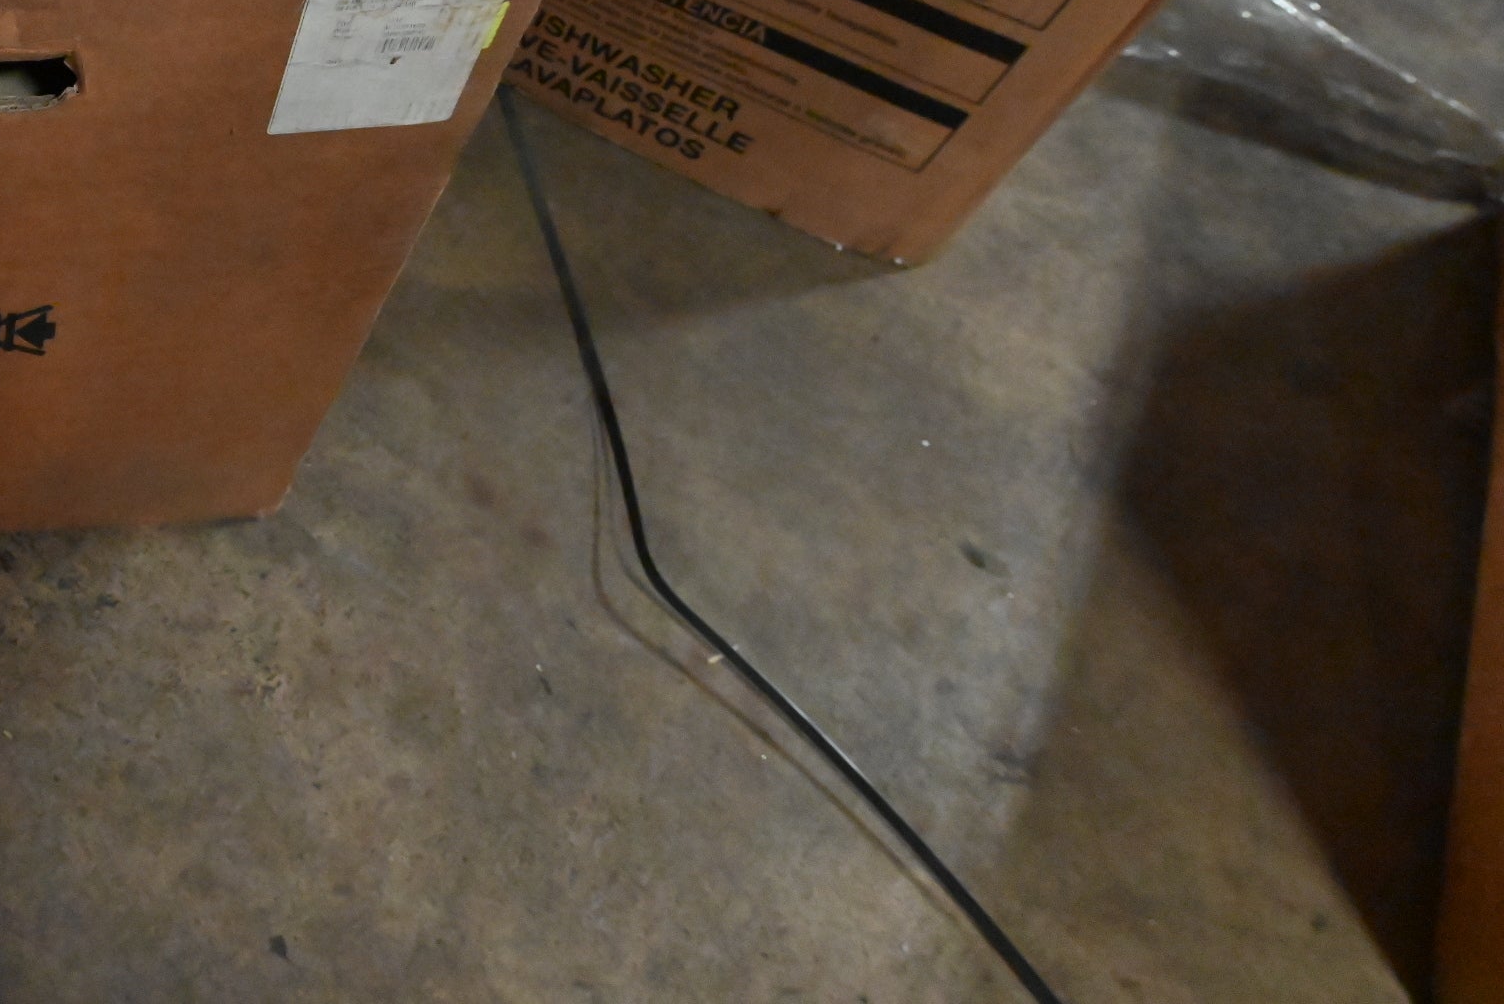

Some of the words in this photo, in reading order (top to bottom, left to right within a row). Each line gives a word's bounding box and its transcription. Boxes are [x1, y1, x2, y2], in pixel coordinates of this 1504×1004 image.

[509, 57, 707, 161] AVAPLATOS
[519, 33, 755, 155] VE-VAISSELLE
[533, 10, 740, 121] ISHWASHER
